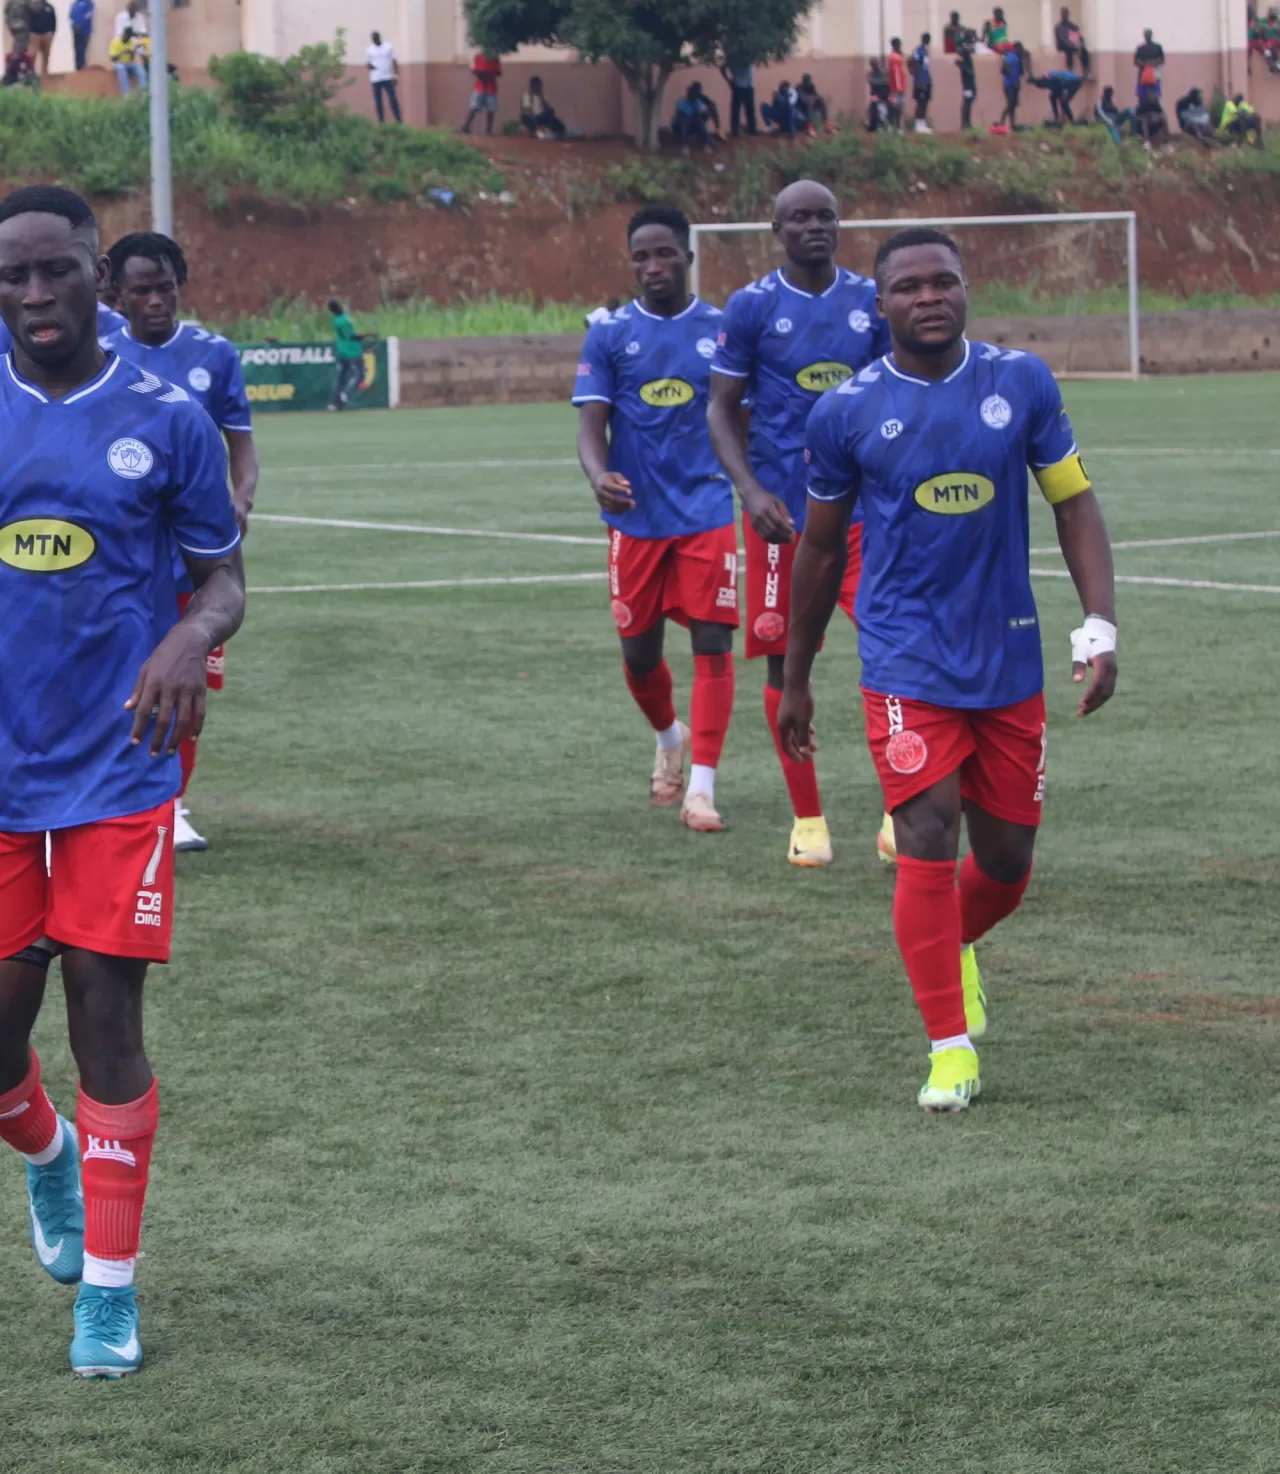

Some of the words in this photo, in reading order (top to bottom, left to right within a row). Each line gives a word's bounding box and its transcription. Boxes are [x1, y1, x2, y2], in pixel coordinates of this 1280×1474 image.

[241, 346, 336, 366] FOOTBALL
[651, 386, 682, 398] MTN
[933, 484, 979, 503] MTN
[15, 534, 72, 556] MTN
